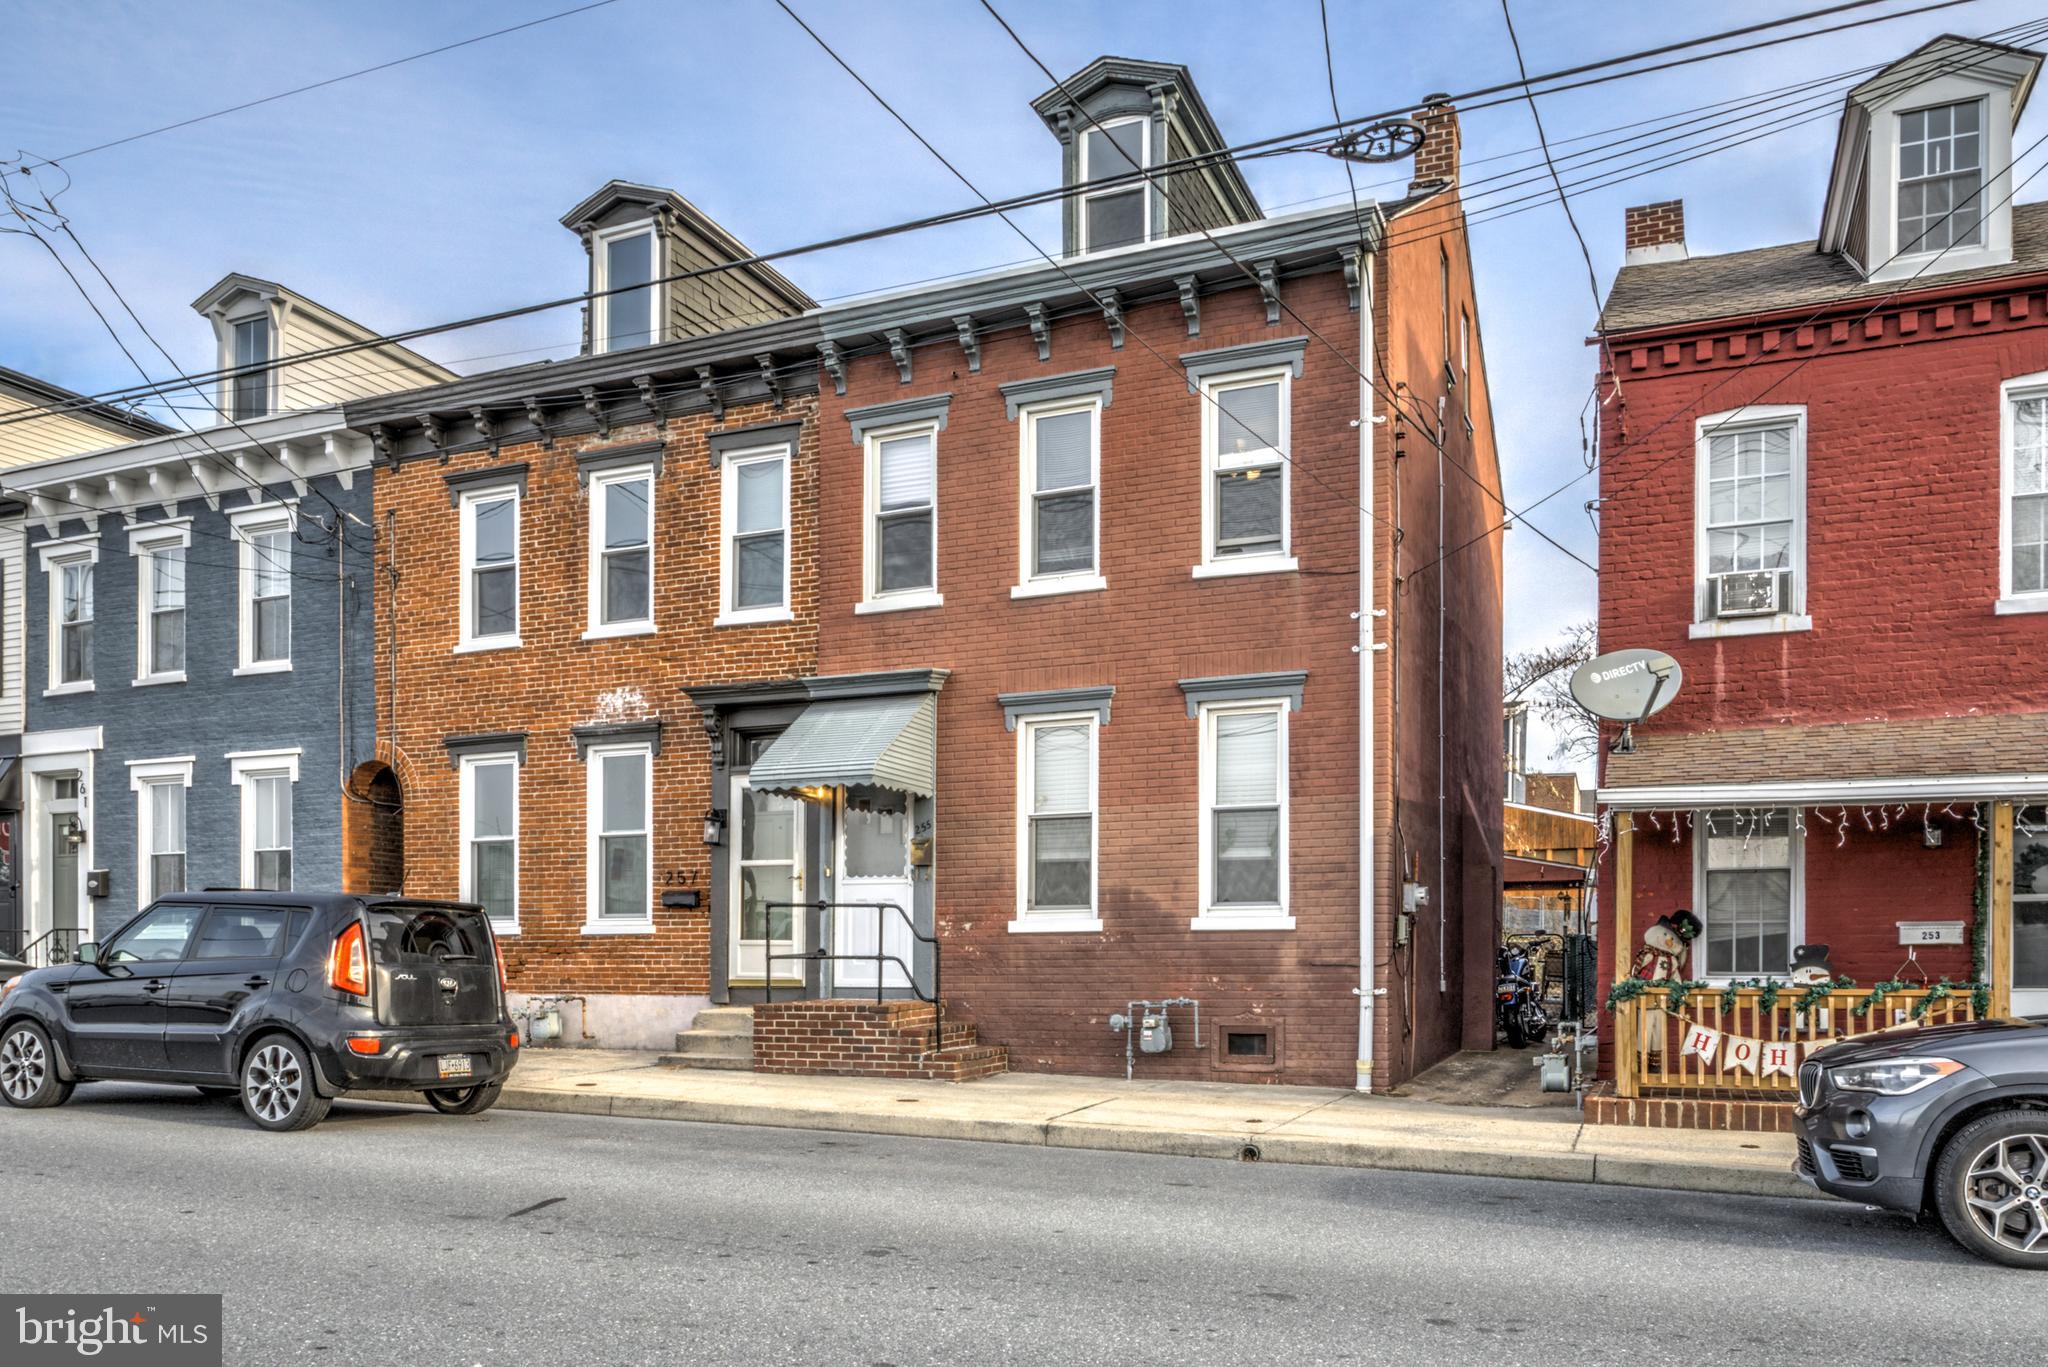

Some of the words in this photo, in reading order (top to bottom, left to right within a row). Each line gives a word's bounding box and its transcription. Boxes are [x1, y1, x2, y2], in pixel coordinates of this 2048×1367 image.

[1602, 659, 1646, 681] DIRECTV
[914, 819, 932, 835] 255
[665, 871, 698, 886] 257
[1921, 931, 1940, 940] 253
